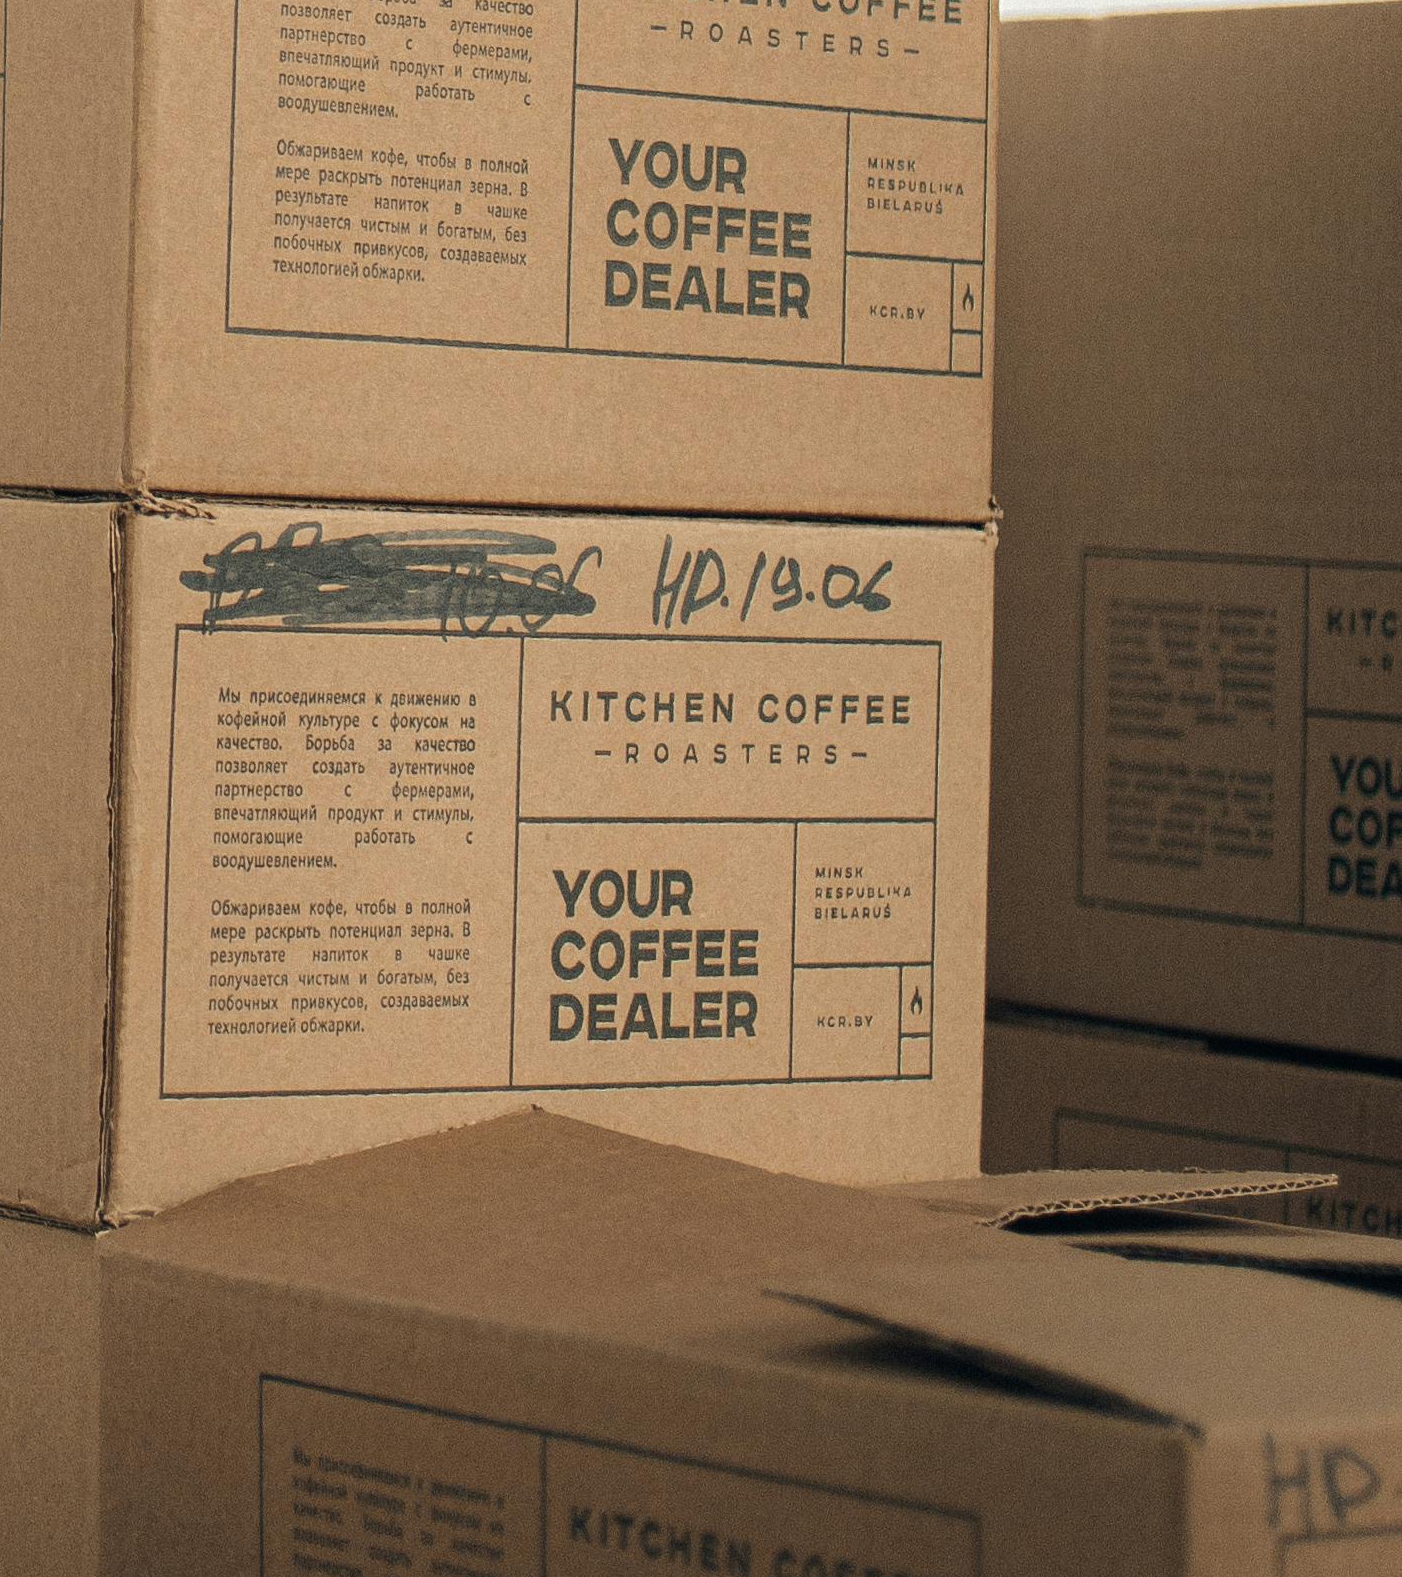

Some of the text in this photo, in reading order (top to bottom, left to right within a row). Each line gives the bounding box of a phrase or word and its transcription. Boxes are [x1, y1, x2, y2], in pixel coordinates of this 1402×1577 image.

[280, 3, 533, 39] позволяет создать аутентичное
[279, 26, 532, 63] партнерство с фермерами,
[278, 49, 379, 71] впечатляющий
[389, 59, 445, 79] продукт
[453, 64, 462, 78] и
[277, 72, 531, 106] помогающие работать с
[277, 95, 398, 118] воодушевлением.
[607, 137, 747, 194] YOUR
[606, 197, 812, 259] COFFEE
[604, 259, 810, 319] DEALER
[217, 686, 477, 708] Мы присоединяемся к движению в
[550, 689, 910, 725] KITCHEN COFFEE
[216, 709, 476, 733] кофейной культуре с фокусом на
[215, 733, 476, 754] качество. Борьба за качество
[214, 759, 475, 778] позволяет создать аутентичное
[214, 780, 474, 802] партнерство с фермерами,
[213, 803, 474, 825] впечатляющий продукт и стимулы,
[212, 826, 473, 848] помогающие работать с
[211, 854, 337, 872] воодушевлением.
[552, 868, 693, 918] YOUR
[210, 897, 471, 919] Обжариваем кофе, чтобы в полной
[209, 920, 471, 943] мере раскрыть потенциал зерна. В
[209, 947, 470, 967] результате напиток в чашке
[550, 928, 759, 981] COFFEE
[208, 966, 469, 991] получается чистым и богатым, без
[207, 993, 469, 1013] побочных привкусов, создаваемых
[206, 1016, 365, 1037] технологией обжарки.
[548, 990, 758, 1041] DEALER
